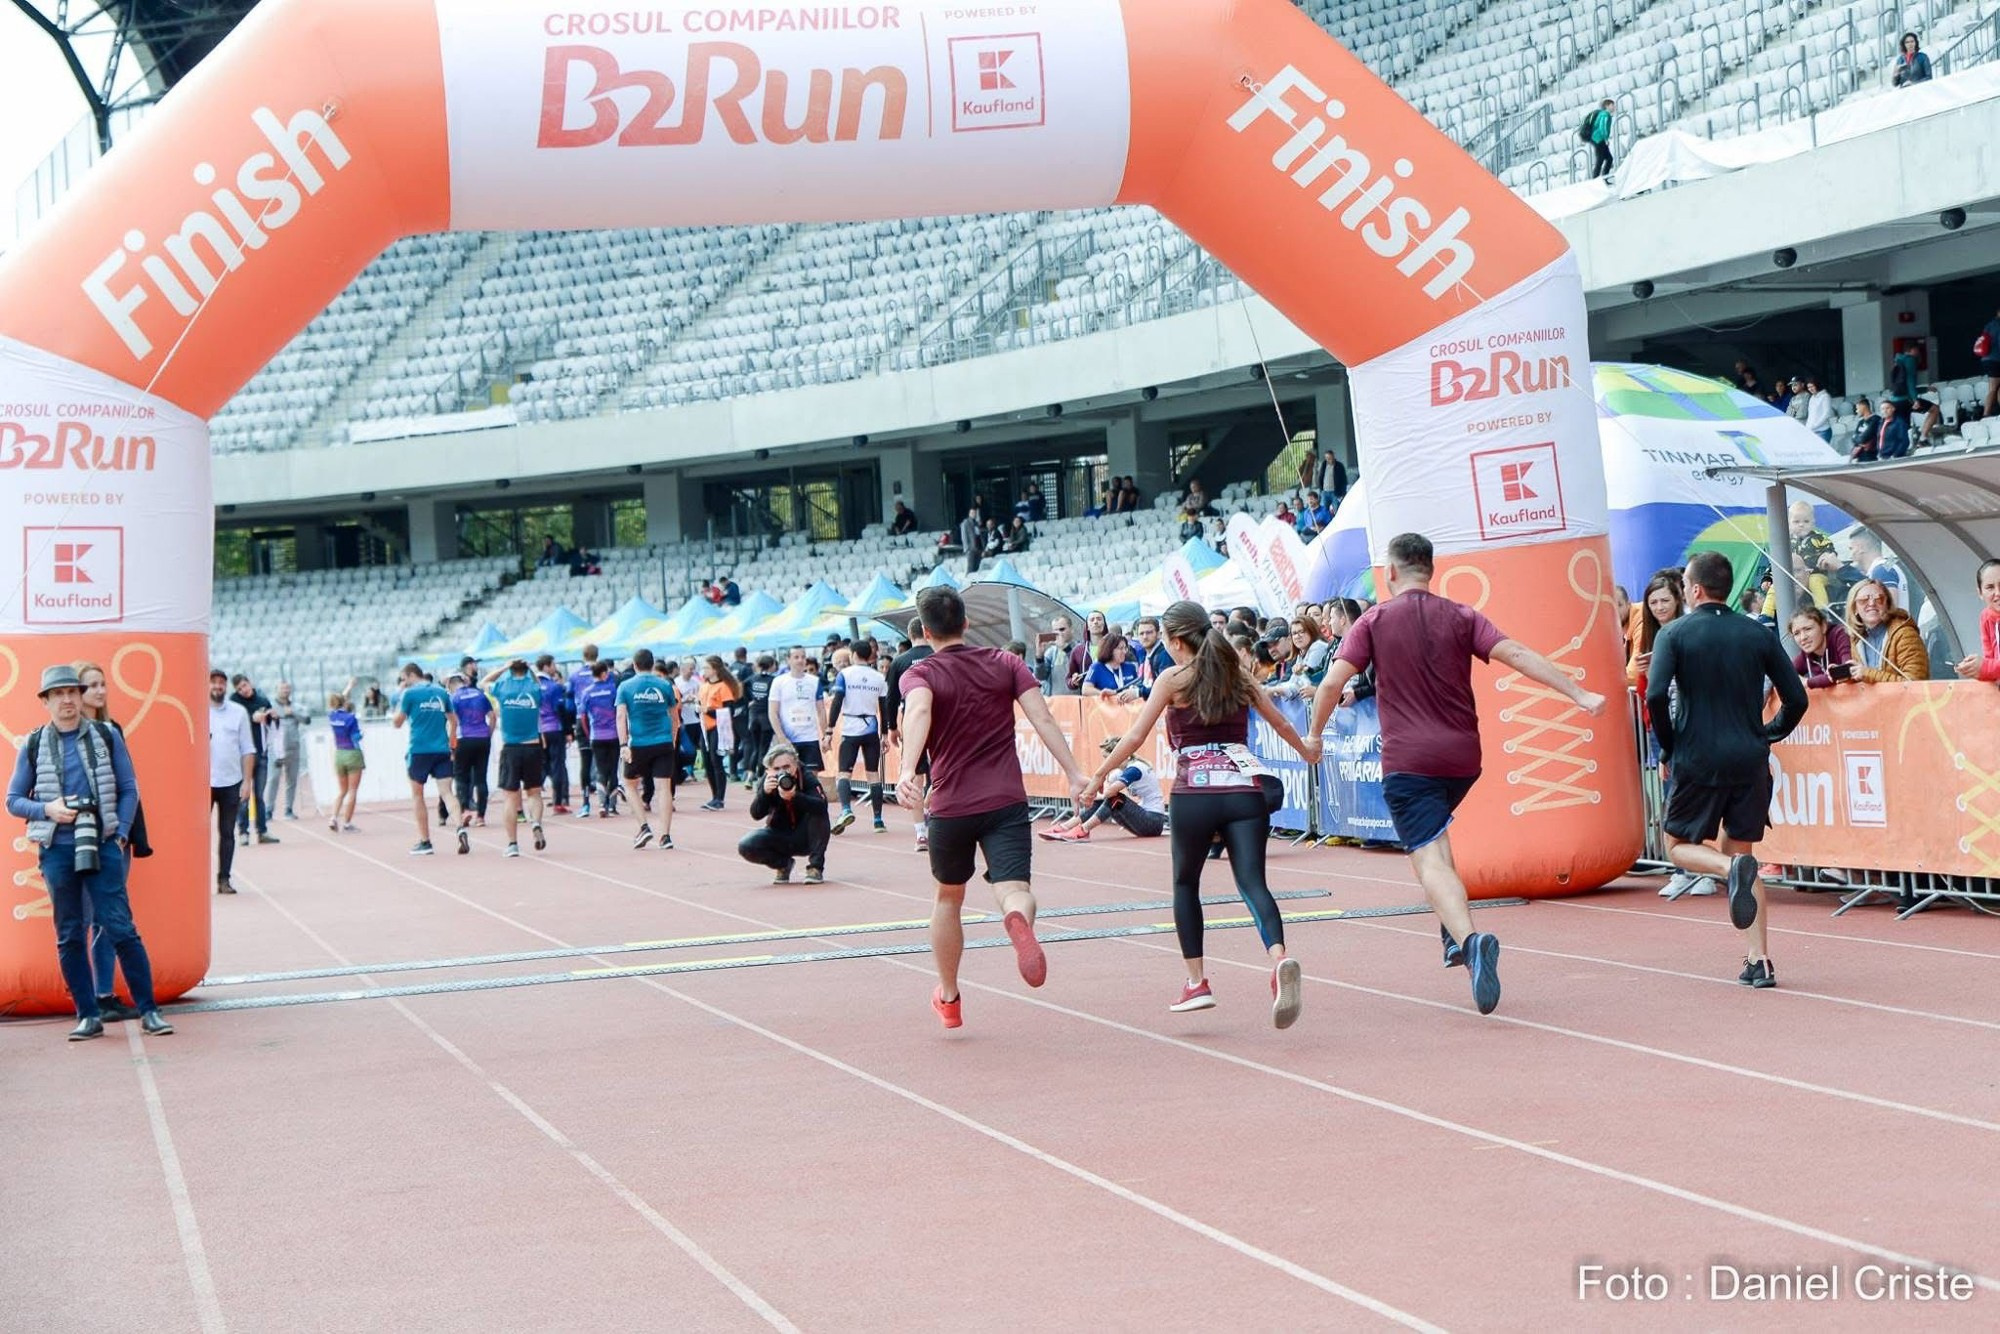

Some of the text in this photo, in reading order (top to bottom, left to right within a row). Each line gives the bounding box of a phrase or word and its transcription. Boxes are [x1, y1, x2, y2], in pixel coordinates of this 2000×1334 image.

[544, 6, 901, 36] CROSUL COMPANIILOR
[944, 6, 1037, 20] POWERED BY
[537, 41, 908, 148] B2Run
[963, 96, 1035, 115] Kaufland
[1226, 64, 1475, 301] Finish
[80, 106, 351, 361] Finish
[1430, 327, 1565, 358] CROSUL COMPANIILOR
[1430, 351, 1570, 407] B2Run
[57, 403, 155, 419] COMPANIILOR
[1467, 411, 1552, 433] POWERED BY
[1642, 449, 1739, 466] TINMAR
[24, 493, 124, 505] POWERED BY
[1489, 505, 1556, 527] Kaufland
[34, 594, 112, 608] Kaufland
[1781, 724, 1830, 745] ANIILOR
[1768, 751, 1834, 826] Run
